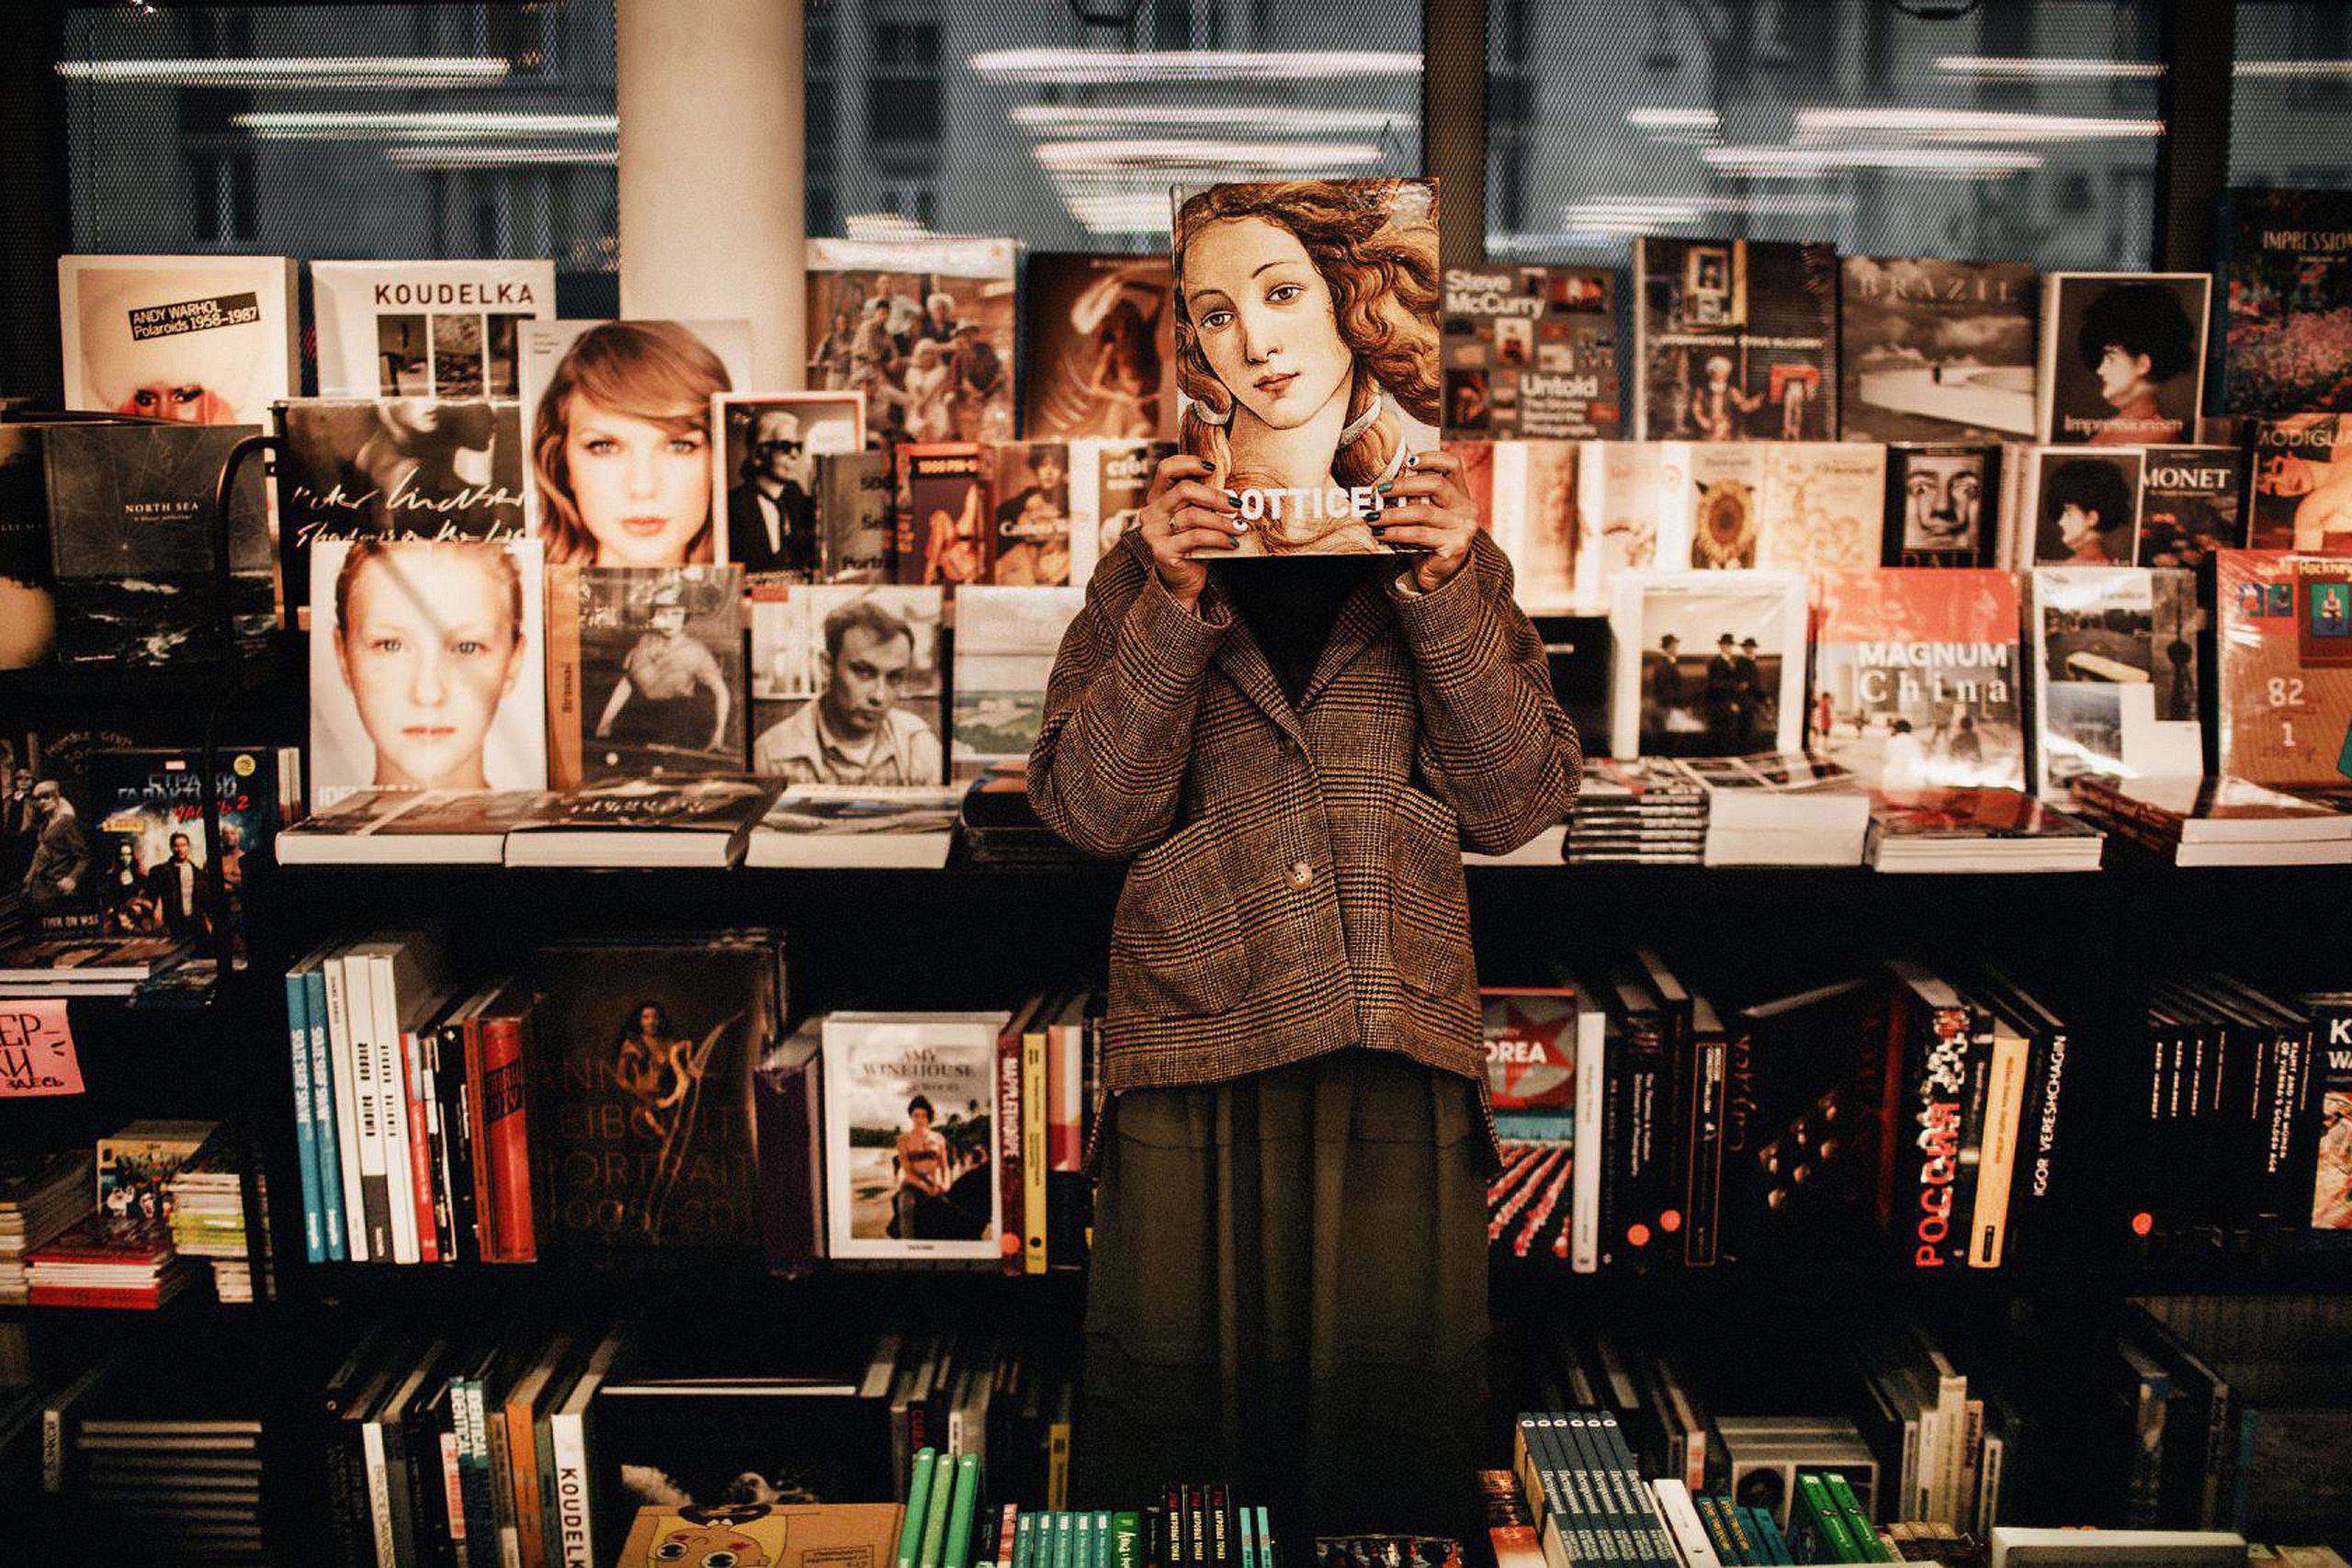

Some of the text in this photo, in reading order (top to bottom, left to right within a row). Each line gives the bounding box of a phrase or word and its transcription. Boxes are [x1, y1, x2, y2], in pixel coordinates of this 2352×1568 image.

[1445, 270, 1511, 291] Steve
[1860, 277, 2010, 301] BRAZIL
[375, 283, 535, 305] KOUDELKA
[1446, 292, 1545, 320] McCurry
[133, 299, 221, 325] ANDY WARHOL
[133, 320, 189, 339] Polaroids
[1521, 374, 1599, 397] Untold
[2142, 467, 2232, 490] MONET
[125, 502, 199, 513] NORTH SEA
[1859, 642, 2007, 668] MAGNUM
[1859, 670, 2009, 703] China
[2267, 677, 2305, 706] 82
[2282, 721, 2296, 747] 1
[864, 1063, 978, 1079] WINEHOUSE
[2032, 1034, 2067, 1197] IGOR VERESHCHAGIN
[2271, 1108, 2283, 1150] GOLDEN
